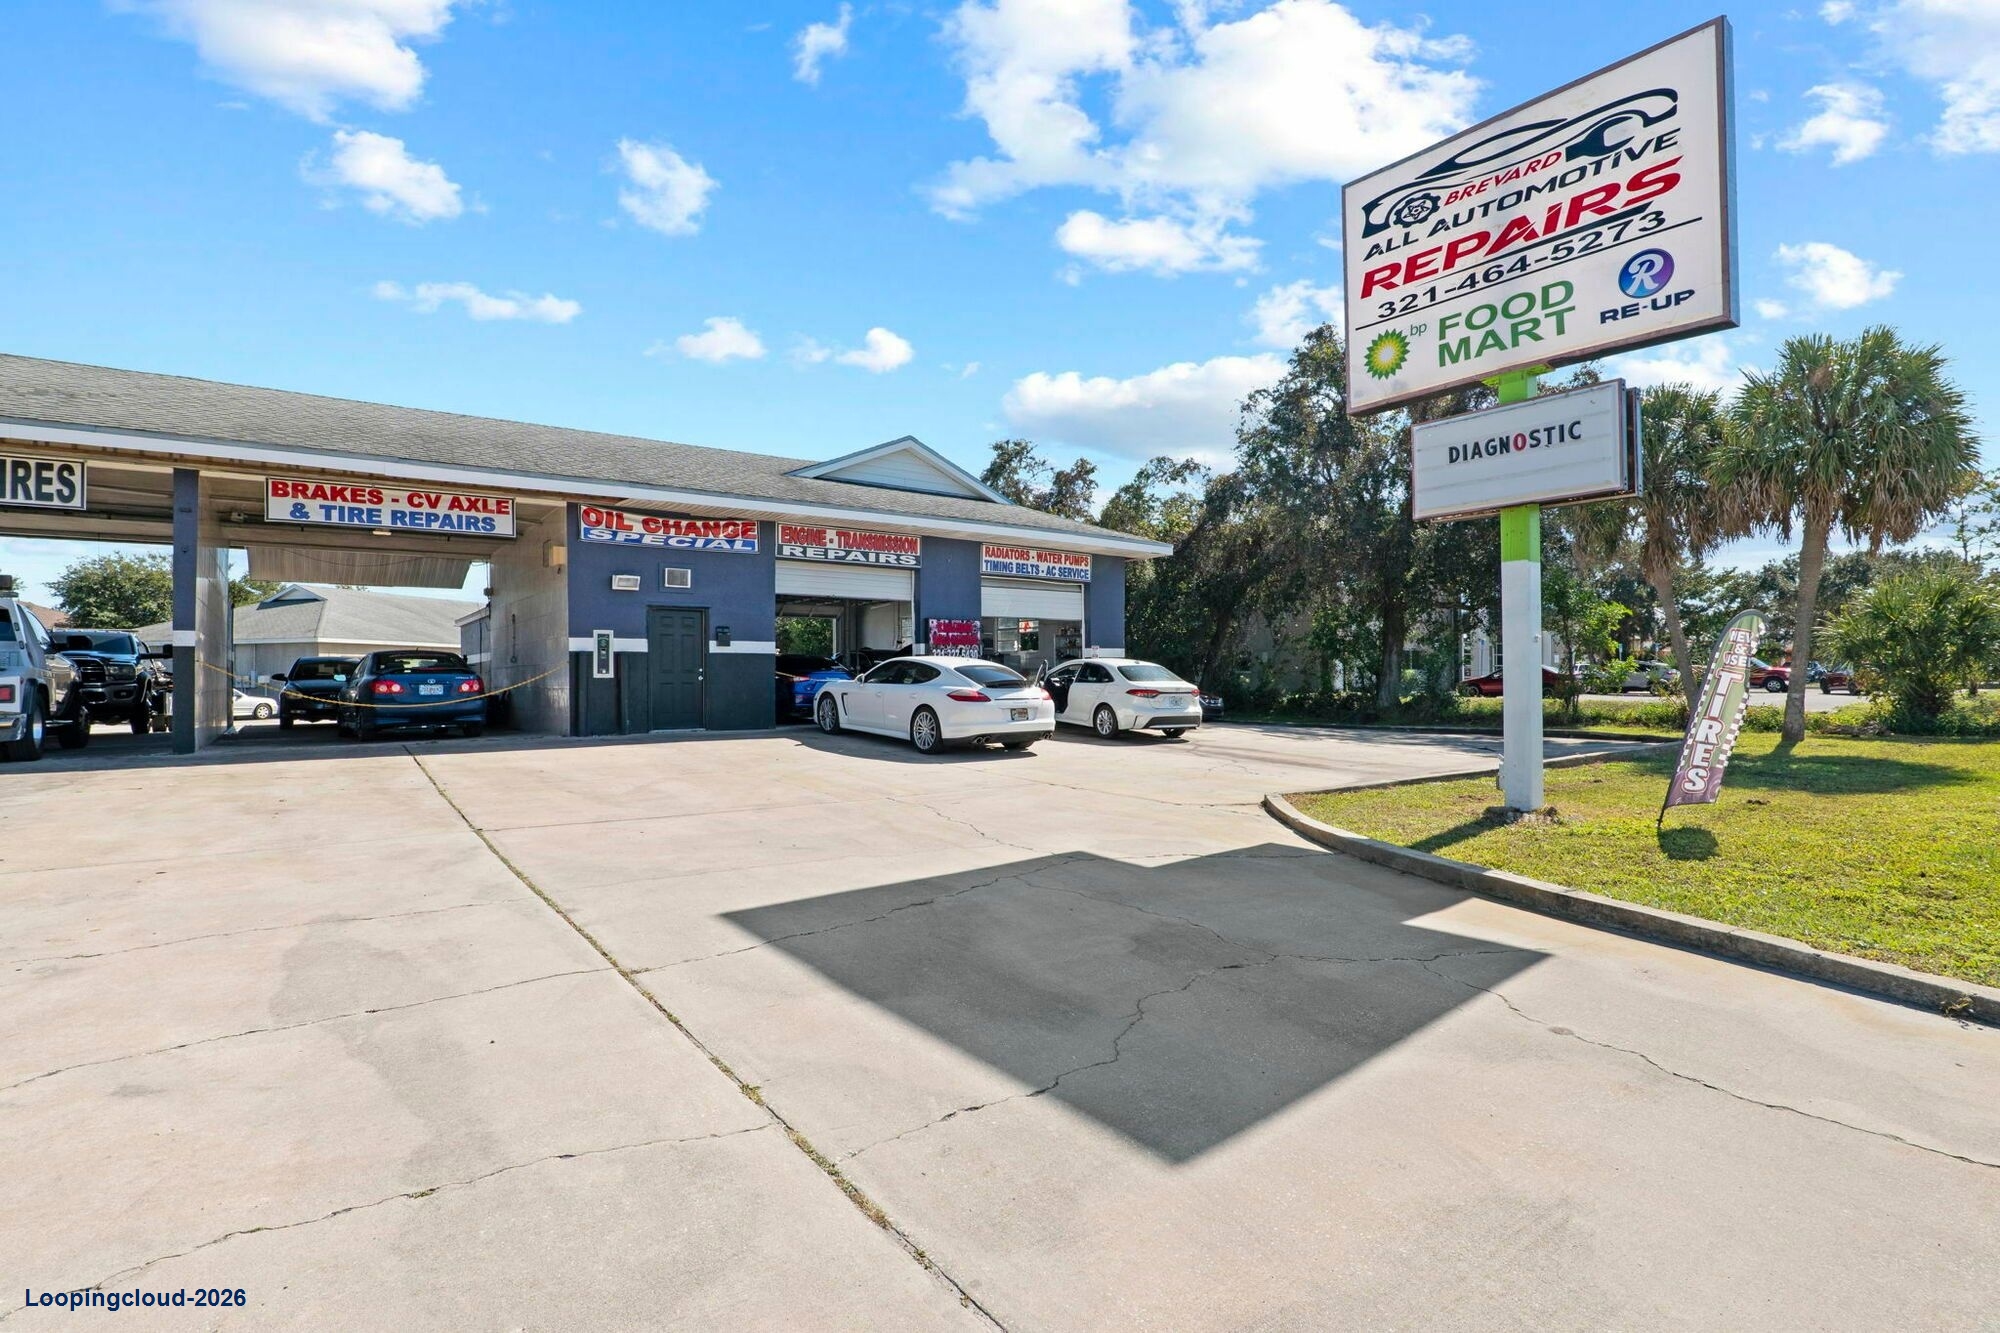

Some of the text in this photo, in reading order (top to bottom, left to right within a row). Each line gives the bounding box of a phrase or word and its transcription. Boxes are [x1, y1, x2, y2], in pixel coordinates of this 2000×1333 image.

[1363, 127, 1681, 262] ALL AUTOMOTIVE
[1443, 151, 1563, 206] BREVARD
[1360, 155, 1684, 299] REPAIRS
[1377, 210, 1667, 318] 321-464-5273
[1438, 279, 1575, 341] FOOD
[1600, 289, 1696, 324] RE-UP
[1410, 322, 1427, 338] bp
[1438, 305, 1576, 368] MART
[1448, 420, 1582, 464] DIAGNOSTIC
[271, 480, 384, 505] BRAKES
[406, 492, 442, 509] CV
[448, 496, 510, 515] AXLE
[289, 502, 496, 532] & TIRE REPAIRS
[581, 506, 757, 539] OIL CHANGE
[587, 528, 753, 550] SPECIAL
[780, 525, 827, 547] ENGINE
[836, 531, 918, 554] TRANSMISSION
[782, 545, 917, 565] REPAIRS
[984, 546, 1030, 561] RADIATORS
[1036, 551, 1063, 564] WATER
[1064, 554, 1089, 567] PUMPS
[984, 560, 1014, 573] TIMING
[1015, 563, 1040, 575] BELTS
[1046, 565, 1057, 576] AC
[1058, 567, 1089, 579] SERVICE
[1683, 670, 1744, 792] TIRES
